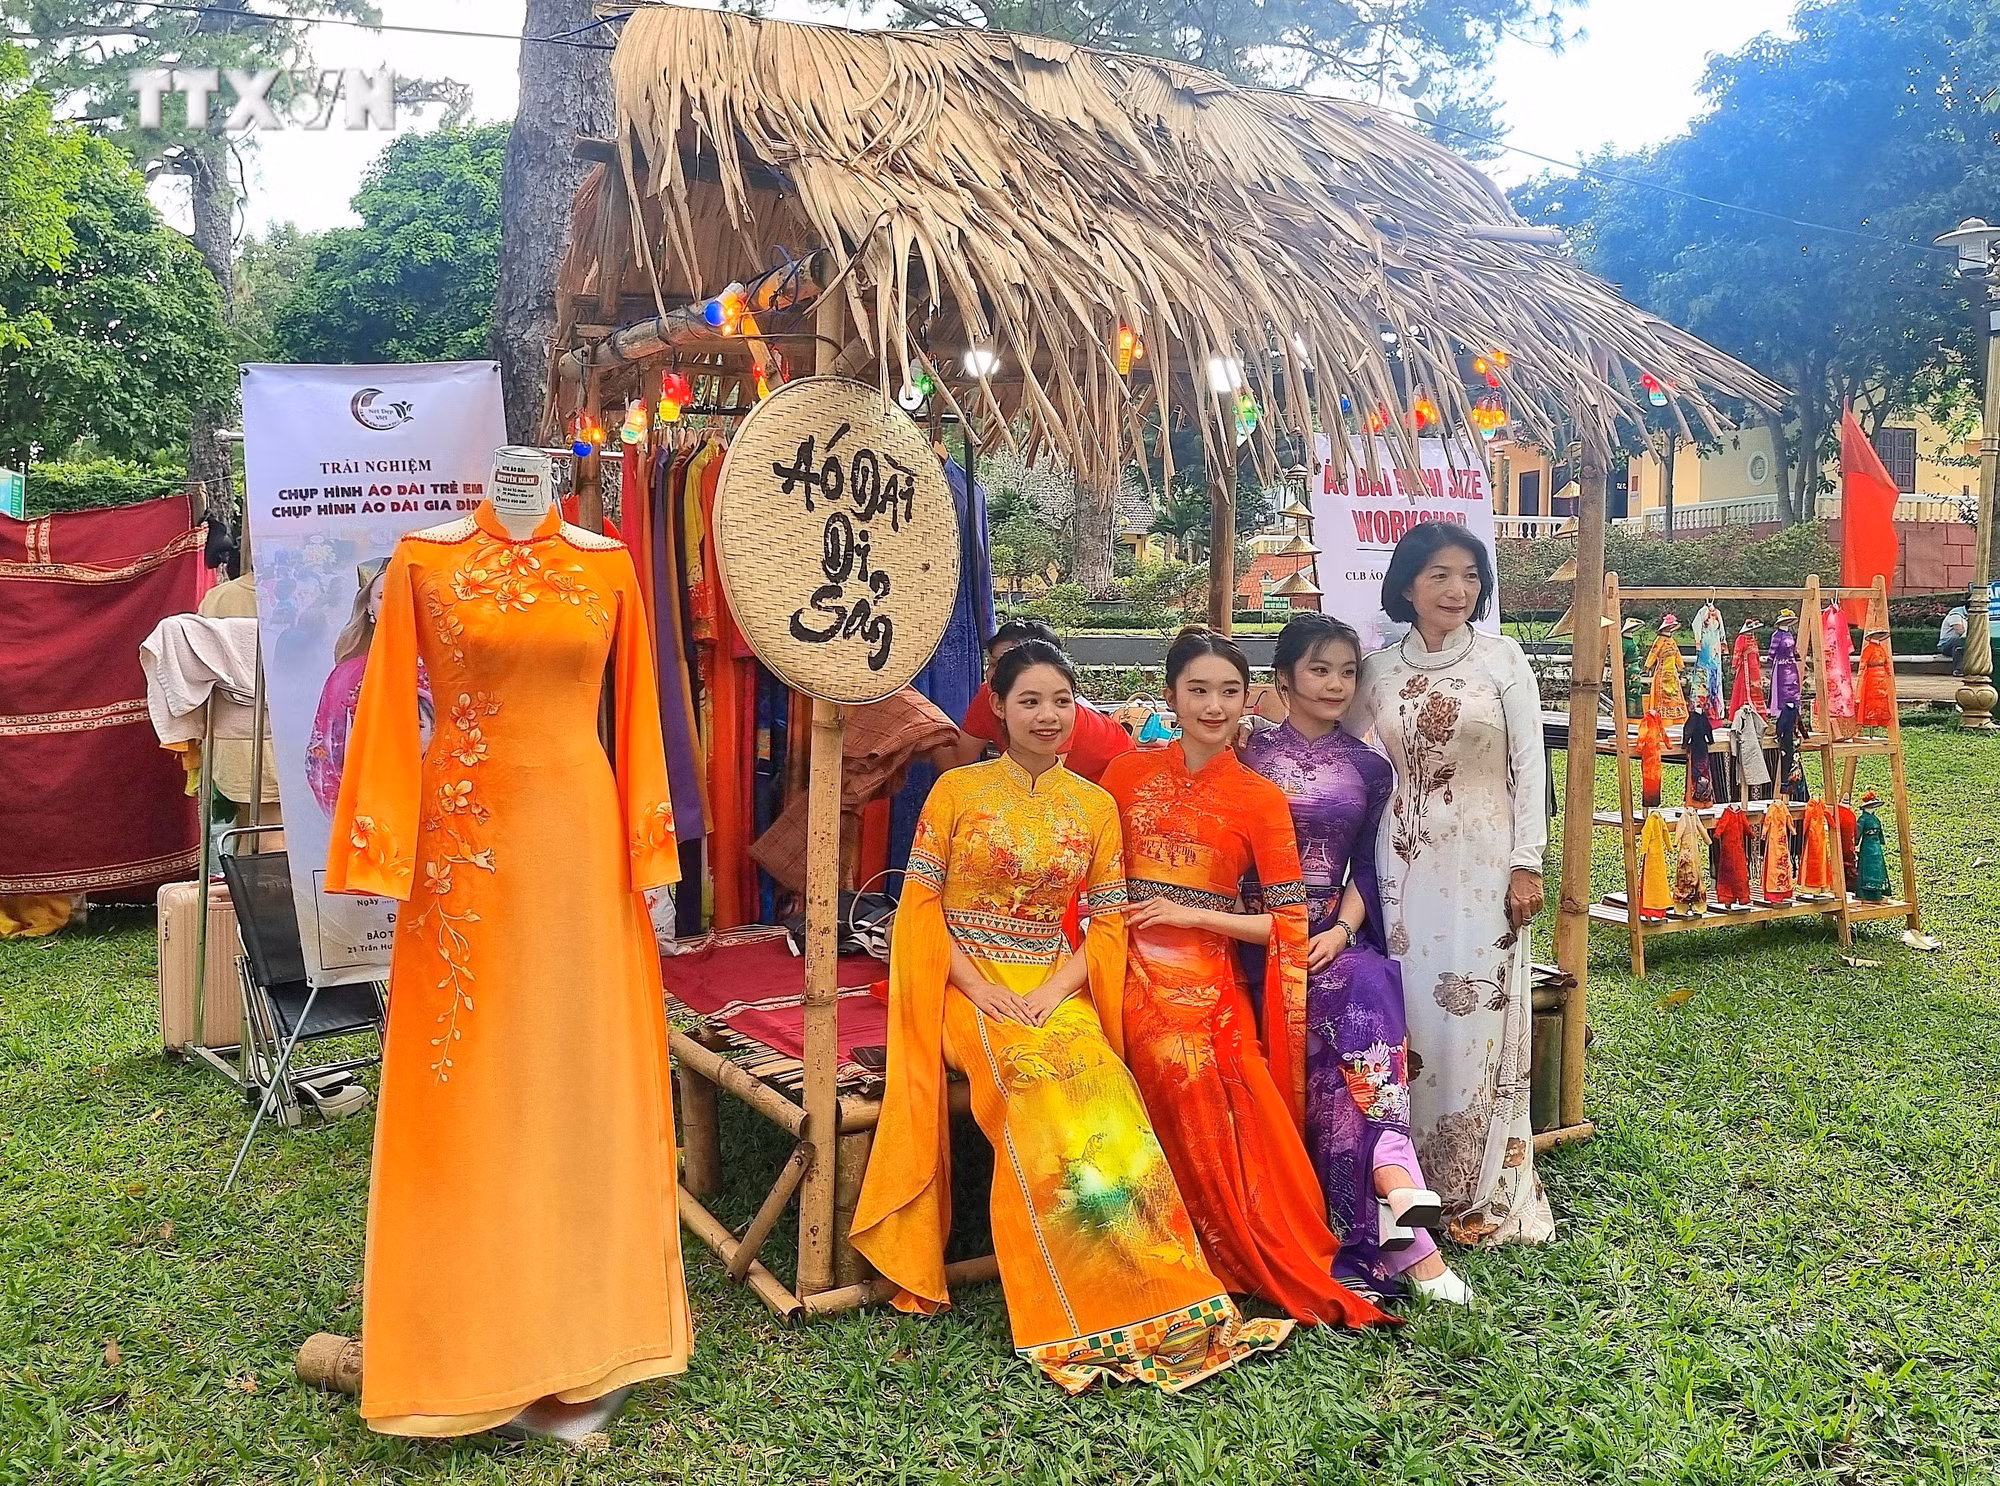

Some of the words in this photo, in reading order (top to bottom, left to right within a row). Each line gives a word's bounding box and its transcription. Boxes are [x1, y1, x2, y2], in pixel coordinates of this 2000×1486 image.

[320, 459, 359, 474] TRẢI
[365, 458, 431, 474] NGHIỆM
[278, 488, 318, 501] CHỤP
[324, 485, 363, 498] HÌNH
[368, 483, 392, 496] ÁO
[397, 482, 425, 496] DÀI
[430, 480, 458, 494] TRẺ
[463, 483, 483, 494] EM
[1393, 468, 1443, 497] NI
[1447, 469, 1483, 499] SIZE
[271, 505, 312, 519] CHỤP
[317, 501, 356, 516] HÌNH
[361, 500, 386, 514] ÁO
[390, 500, 418, 512] DÀI
[424, 500, 451, 511] GIA
[1345, 571, 1366, 581] CLB
[1369, 569, 1383, 580] ÁO
[357, 898, 379, 906] Ngày
[367, 930, 387, 940] BẢO
